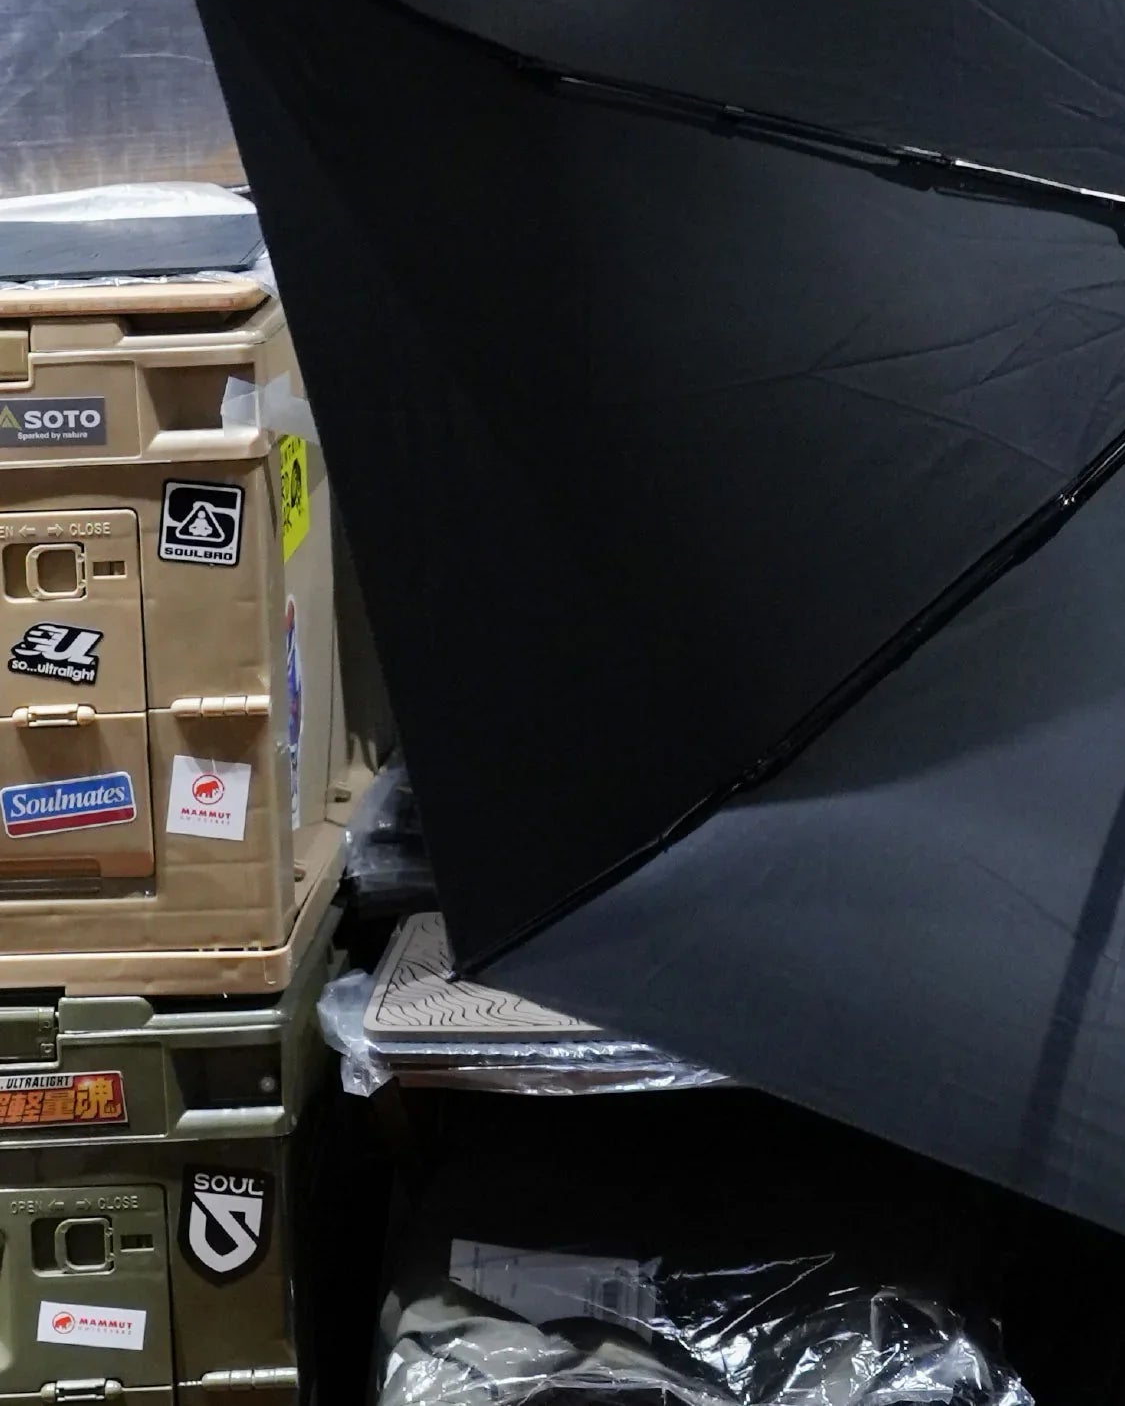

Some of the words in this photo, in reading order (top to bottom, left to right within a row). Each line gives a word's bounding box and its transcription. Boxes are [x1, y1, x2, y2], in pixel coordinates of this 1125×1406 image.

[24, 409, 101, 429] SOTO
[18, 431, 49, 441] Sparked
[51, 431, 61, 441] by
[62, 431, 88, 439] nature
[69, 521, 112, 536] CLOSE
[164, 546, 234, 561] SOULBRO
[10, 785, 126, 819] Soulmates
[181, 807, 232, 820] MAMMUT
[193, 1173, 264, 1196] SOUL
[97, 1195, 139, 1210] CLOSE
[78, 1317, 133, 1330] MAMMUT
